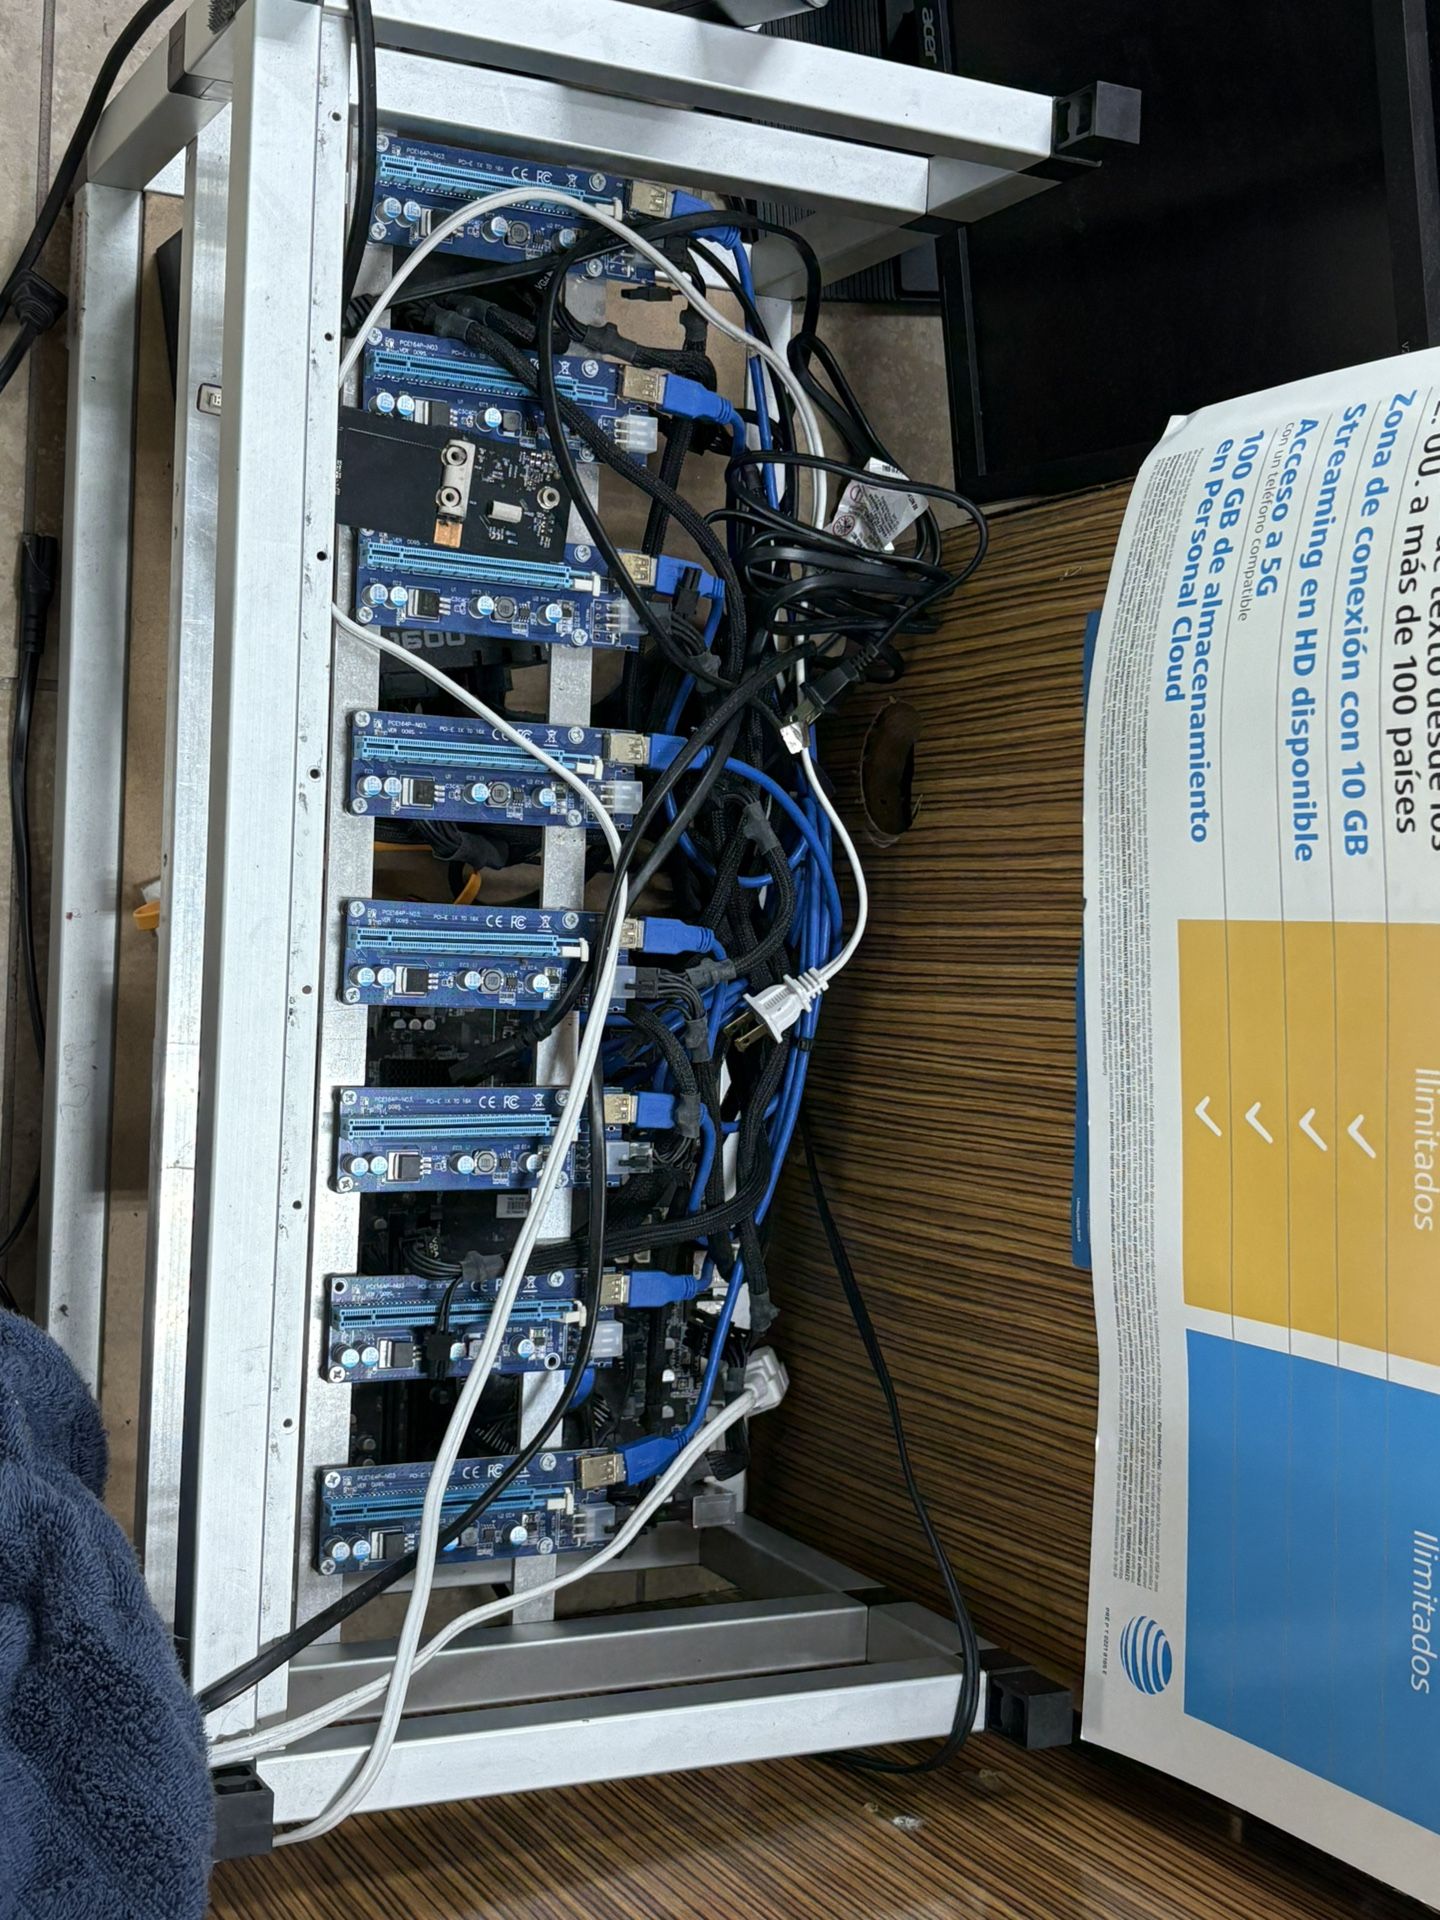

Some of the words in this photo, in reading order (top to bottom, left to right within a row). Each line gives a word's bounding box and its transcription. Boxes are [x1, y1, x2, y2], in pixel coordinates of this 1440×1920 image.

[922, 7, 937, 64] acer
[511, 166, 529, 180] CE
[1279, 422, 1295, 451] con
[1370, 390, 1417, 469] Zona
[1209, 438, 1234, 474] en
[1231, 430, 1265, 481] 100
[1270, 451, 1284, 472] un
[1270, 418, 1319, 522] Acceso
[1218, 487, 1245, 530] GB
[1255, 472, 1278, 535] teléfono
[1299, 403, 1368, 571] Streaming
[1360, 476, 1390, 517] de
[1410, 497, 1429, 514] a
[1175, 478, 1224, 608] Personal
[1209, 537, 1233, 575] de
[1264, 532, 1283, 549] a
[1398, 525, 1427, 594] más
[1238, 537, 1262, 622] compatible
[1255, 557, 1281, 598] 5G
[1297, 578, 1319, 620] en
[1340, 527, 1375, 682] conexión
[1394, 605, 1422, 645] de
[1164, 615, 1193, 703] Cloud
[1292, 628, 1318, 677] HD
[1393, 655, 1417, 715] 100
[1187, 582, 1223, 844] almacenamiento
[1340, 691, 1360, 752] con
[1285, 687, 1319, 863] disponible
[1341, 761, 1366, 800] 10
[1386, 728, 1421, 834] países
[1343, 809, 1369, 858] GB
[486, 914, 503, 928] CE
[478, 1095, 496, 1109] CE
[1414, 1068, 1440, 1231] Ilimitados
[469, 1280, 488, 1293] CE
[462, 1465, 480, 1479] CE
[1410, 1530, 1440, 1694] Ilimitados
